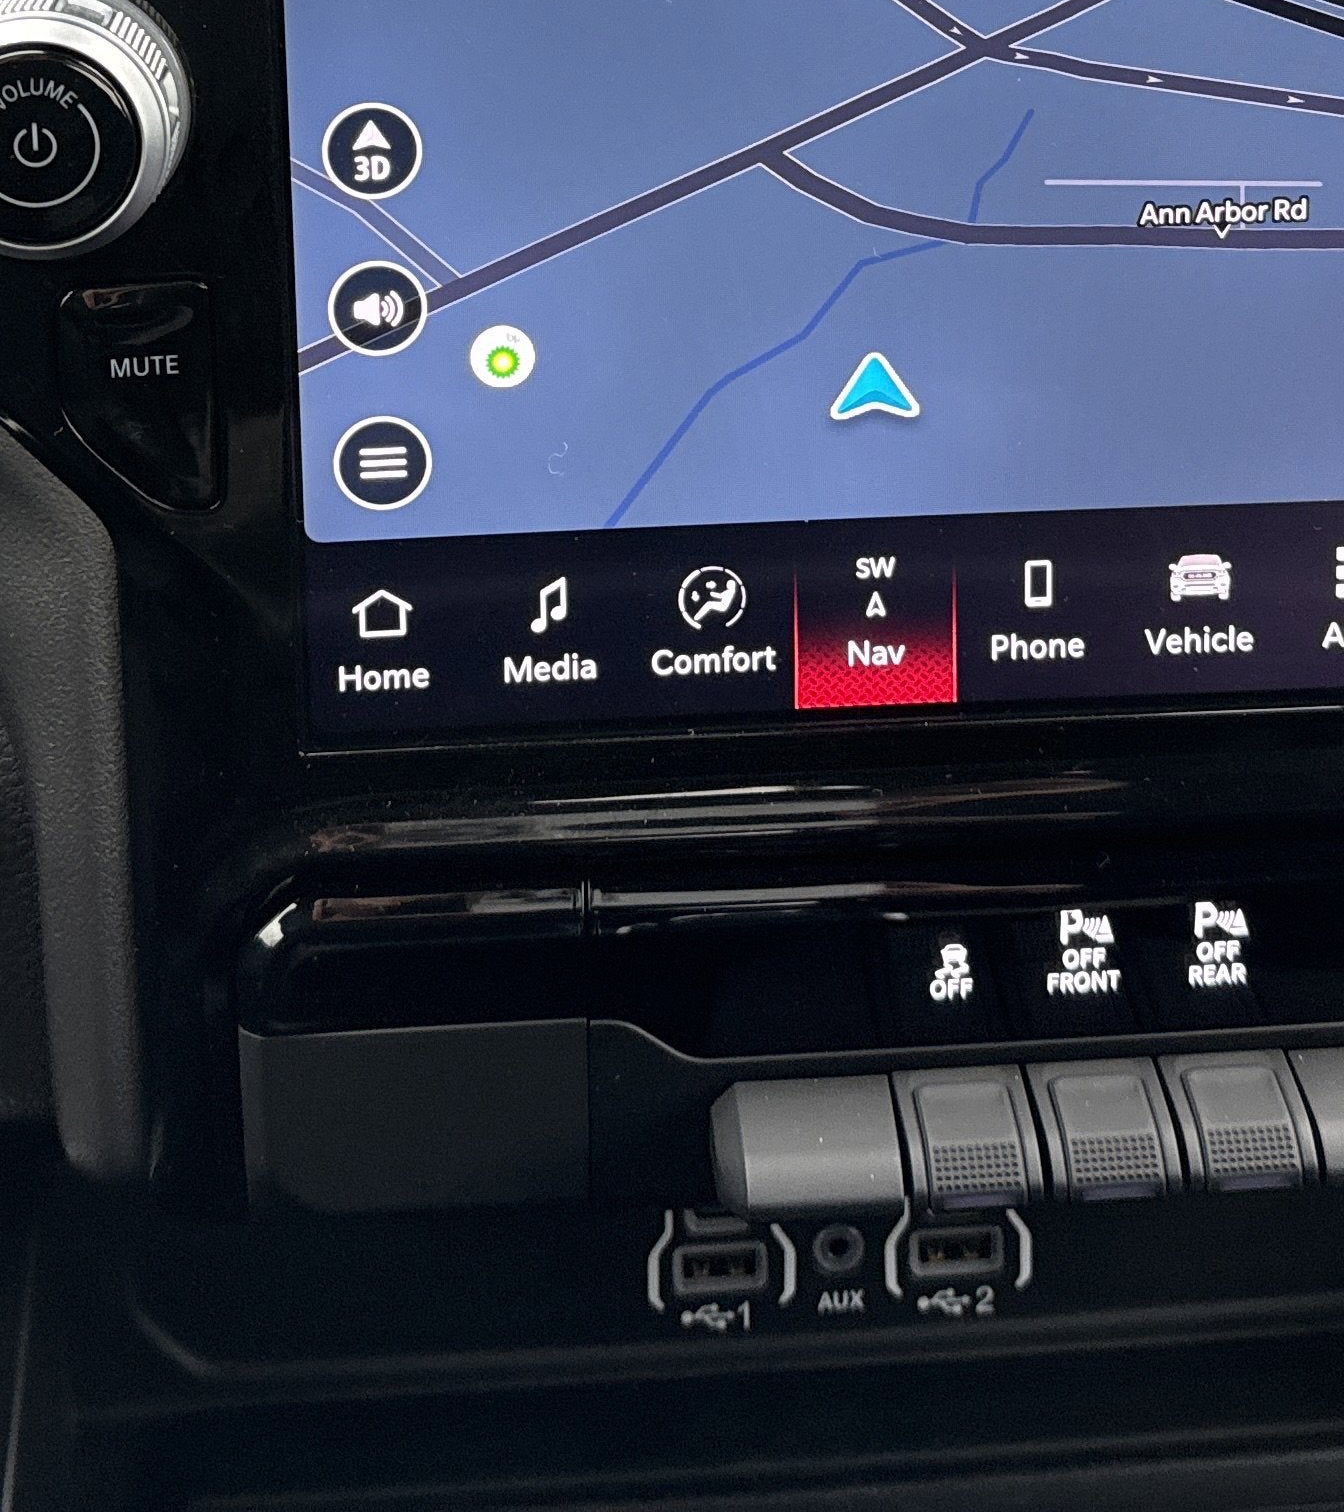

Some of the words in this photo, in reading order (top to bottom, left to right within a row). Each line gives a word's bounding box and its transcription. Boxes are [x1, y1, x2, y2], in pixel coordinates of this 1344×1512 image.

[353, 155, 391, 182] 3D
[1139, 203, 1191, 227] Ann
[1195, 199, 1270, 225] Arbor
[1274, 197, 1308, 222] Rd
[110, 354, 180, 378] MUTE
[855, 555, 896, 579] SW
[990, 633, 1085, 662] Phone
[1144, 624, 1255, 656] Vehicle
[651, 646, 776, 677] Comfort
[847, 640, 906, 667] Nav
[337, 666, 431, 692] Home
[503, 653, 598, 684] Media
[1062, 947, 1107, 970] OFF
[1196, 940, 1241, 963] OFF
[1046, 970, 1121, 995] FRONT
[1188, 964, 1247, 988] REAR
[930, 978, 973, 1001] OFF
[817, 1289, 865, 1314] AUX
[975, 1286, 995, 1315] 2
[738, 1301, 751, 1329] 1
